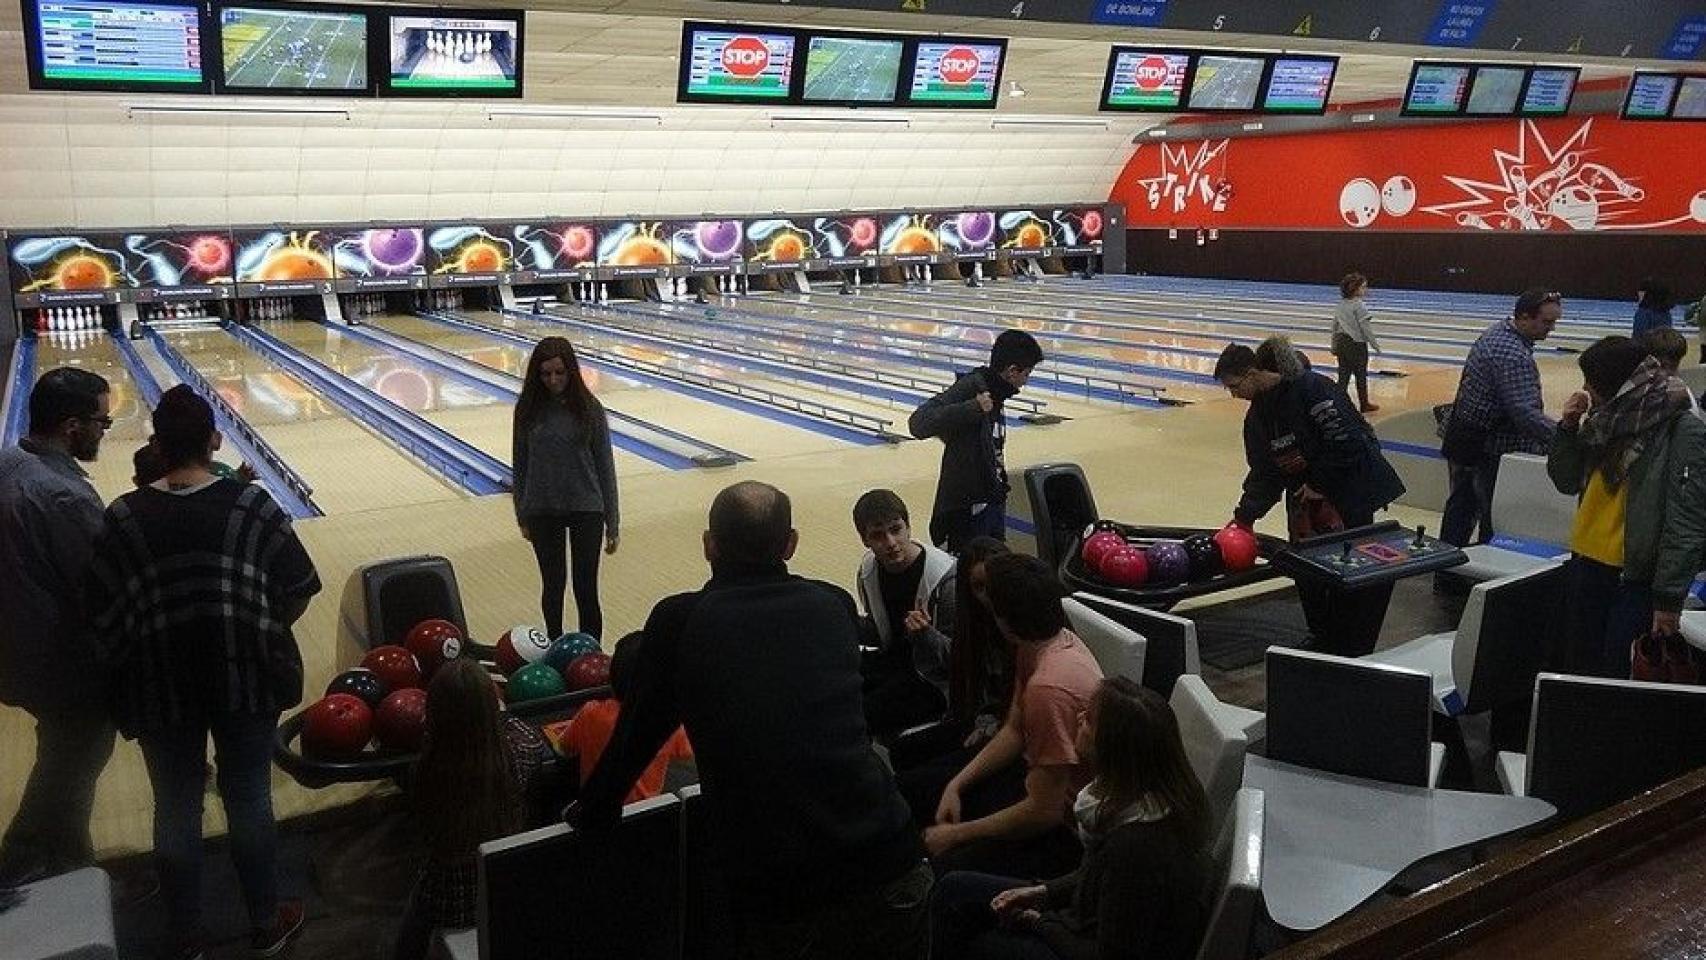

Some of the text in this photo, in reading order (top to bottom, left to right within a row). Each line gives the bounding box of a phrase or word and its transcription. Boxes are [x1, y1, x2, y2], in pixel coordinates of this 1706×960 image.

[1010, 1, 1025, 18] 4
[1212, 14, 1226, 31] 5
[724, 48, 767, 66] STOP
[942, 58, 977, 74] STOP
[1136, 65, 1167, 80] STOP
[1148, 172, 1227, 213] STRIKE
[221, 287, 230, 298] 2
[323, 282, 332, 294] 3
[114, 291, 121, 303] 1
